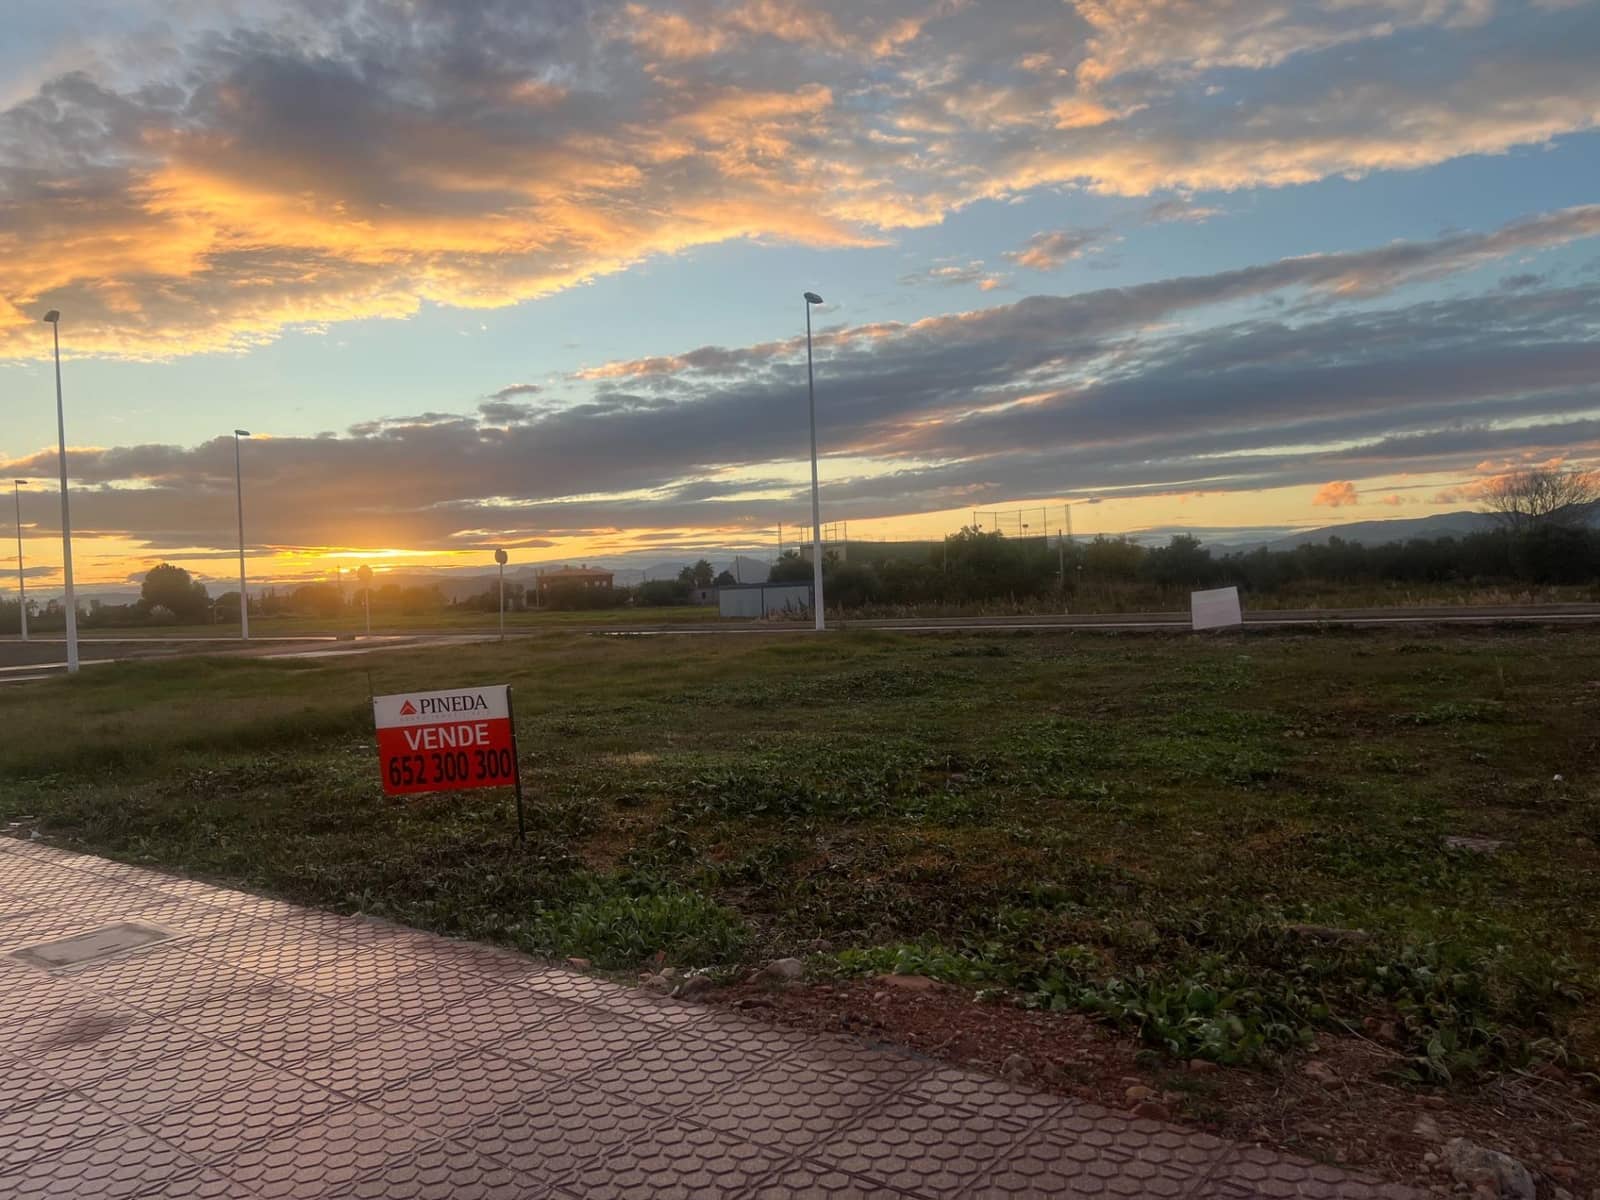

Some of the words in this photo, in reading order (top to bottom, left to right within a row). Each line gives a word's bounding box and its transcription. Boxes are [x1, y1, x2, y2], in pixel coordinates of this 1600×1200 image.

[420, 695, 488, 714] PINEDA
[403, 723, 490, 751] VENDE
[389, 755, 426, 787] 652
[431, 751, 469, 783] 300
[474, 748, 512, 779] 300
